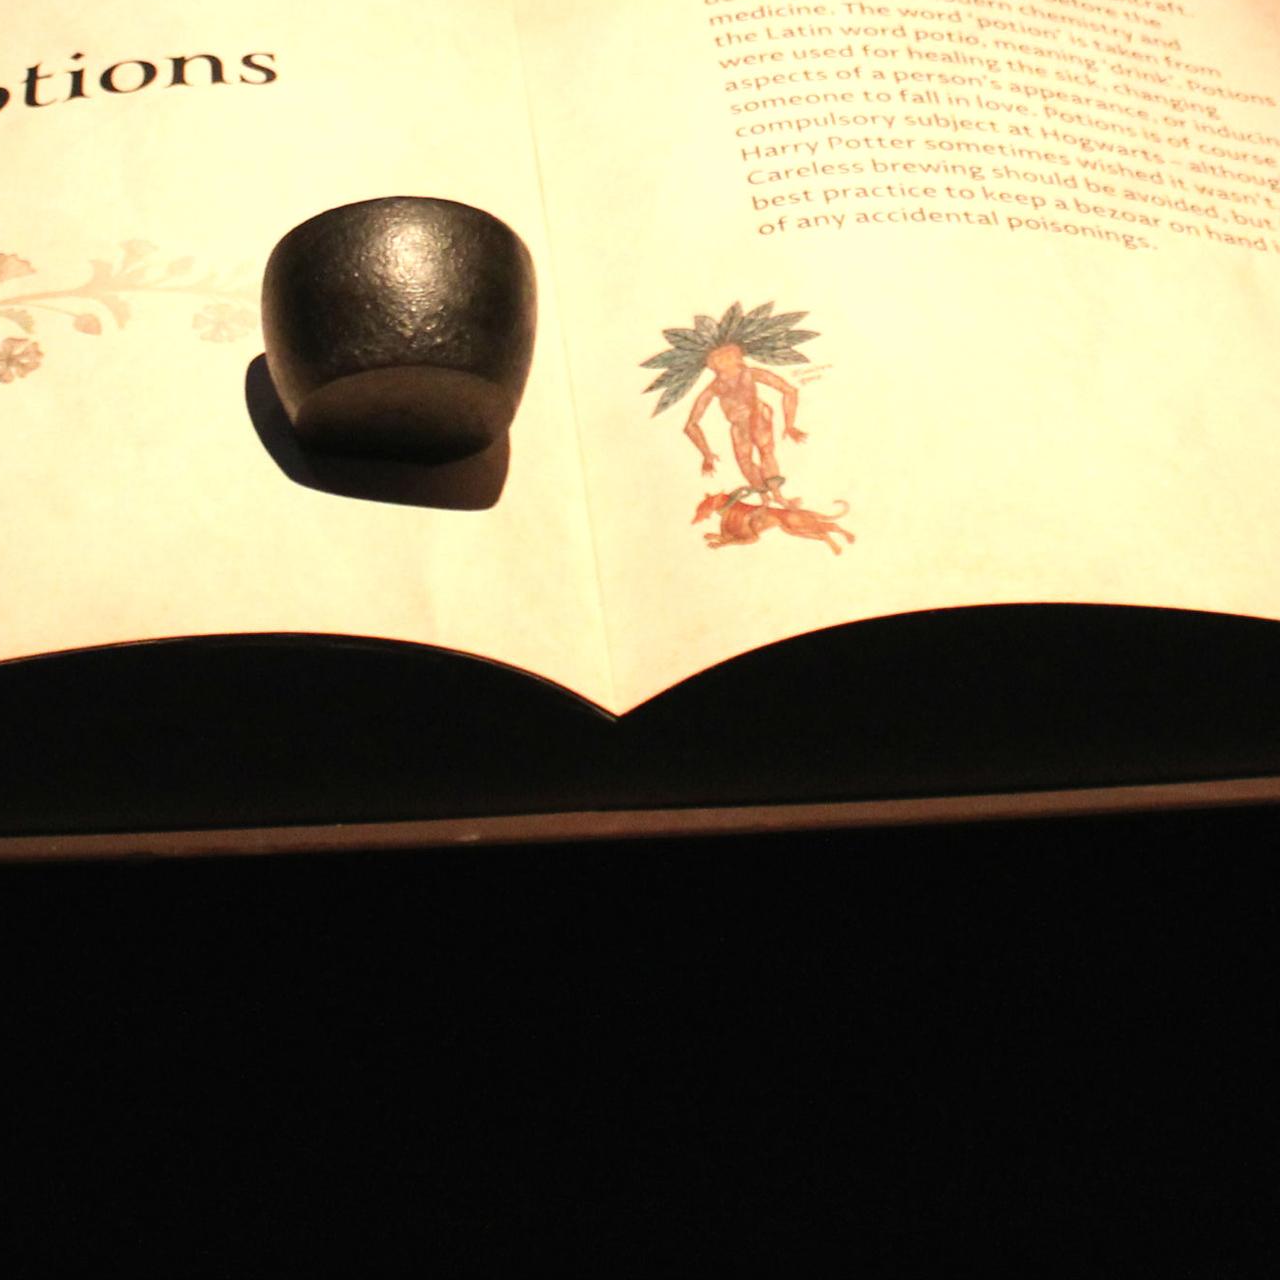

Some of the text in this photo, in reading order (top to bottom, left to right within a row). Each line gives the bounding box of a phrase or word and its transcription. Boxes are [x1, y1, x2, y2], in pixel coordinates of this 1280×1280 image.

[708, 4, 836, 27] medicine.
[839, 1, 891, 15] The
[896, 7, 962, 23] word
[1069, 32, 1088, 49] is
[1091, 39, 1160, 64] taken
[1163, 55, 1223, 79] from
[1018, 4, 1133, 43] chemistry
[1140, 34, 1182, 52] and
[1122, 10, 1162, 29] the
[713, 30, 759, 48] the
[765, 24, 833, 40] Latin
[839, 24, 908, 39] word
[913, 29, 988, 49] potio,
[991, 40, 1100, 73] meaning
[1185, 79, 1279, 107] Potions
[718, 50, 785, 70] were
[791, 44, 854, 61] used
[860, 44, 900, 59] for
[905, 45, 1002, 74] healing
[1006, 60, 1047, 77] the
[1112, 83, 1220, 120] changing
[724, 69, 828, 92] aspects
[835, 64, 862, 80] of
[871, 69, 886, 81] a
[892, 70, 1002, 90] person's
[1163, 115, 1186, 128] or
[729, 91, 855, 115] someone
[862, 89, 892, 103] to
[898, 88, 941, 105] fall
[946, 93, 971, 108] in
[975, 94, 1039, 118] love.
[1042, 104, 1137, 137] Potions
[1141, 127, 1162, 143] is
[1166, 136, 1191, 150] of
[1198, 143, 1277, 168] course
[734, 112, 897, 138] compulsory
[903, 112, 1001, 133] subject
[1007, 124, 1036, 139] at
[1039, 126, 1166, 165] Hogwarts
[739, 139, 820, 162] Harry
[826, 135, 917, 150] Potter
[923, 140, 1072, 166] sometimes
[1075, 157, 1165, 185] wished
[1168, 175, 1188, 191] it
[746, 160, 865, 186] Careless
[871, 158, 986, 181] brewing
[991, 164, 1079, 190] should
[1083, 177, 1117, 194] be
[1231, 208, 1275, 232] but
[751, 188, 815, 212] best
[822, 184, 938, 205] practice
[944, 185, 976, 201] to
[981, 186, 1048, 211] keep
[1054, 198, 1071, 212] a
[1072, 197, 1162, 228] bezoar
[1168, 220, 1202, 237] on
[1203, 224, 1269, 252] hand
[757, 206, 1160, 251] of any accidental poisonings.
